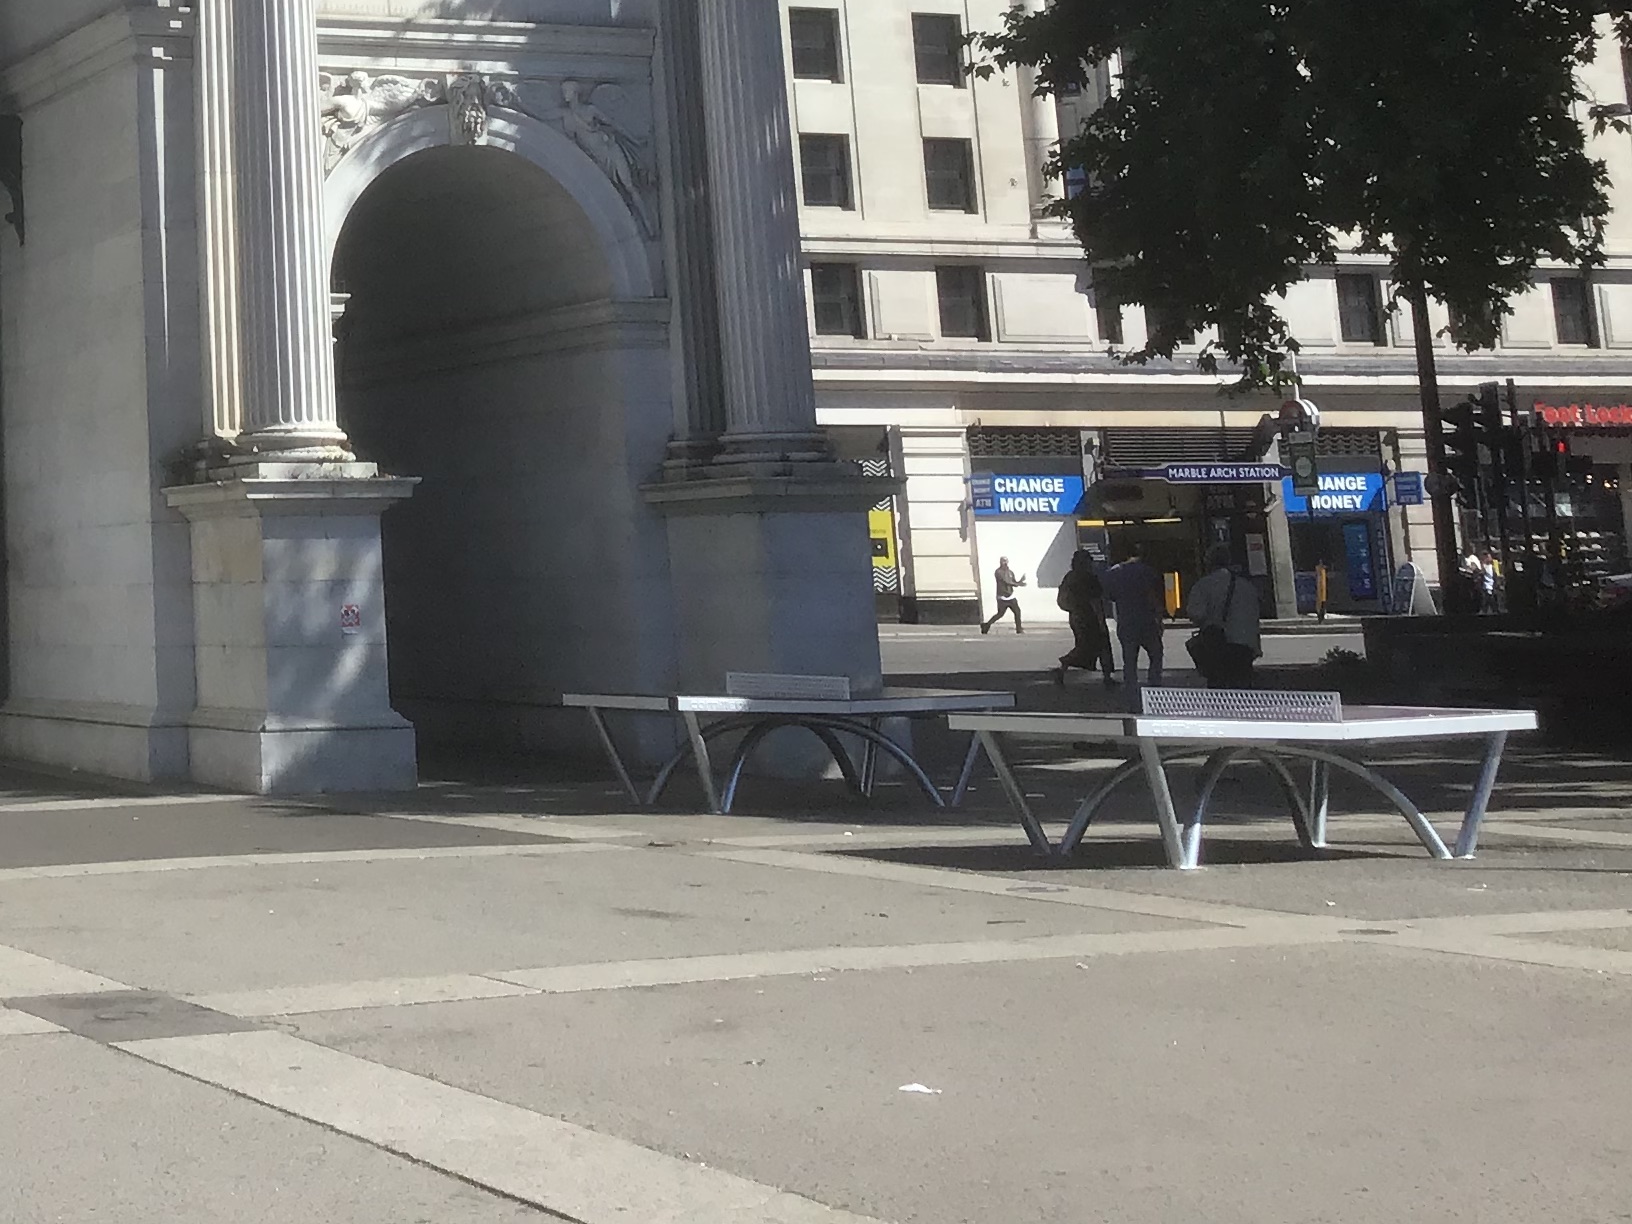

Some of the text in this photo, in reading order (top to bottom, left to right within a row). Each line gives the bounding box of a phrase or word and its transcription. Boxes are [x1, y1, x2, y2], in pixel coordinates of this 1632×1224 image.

[1168, 467, 1279, 478] MARBLE ARCH STATION
[994, 478, 1065, 493] CHANGE
[1318, 476, 1367, 491] HANGE
[999, 497, 1060, 512] MONEY
[1311, 495, 1363, 509] MONEY
